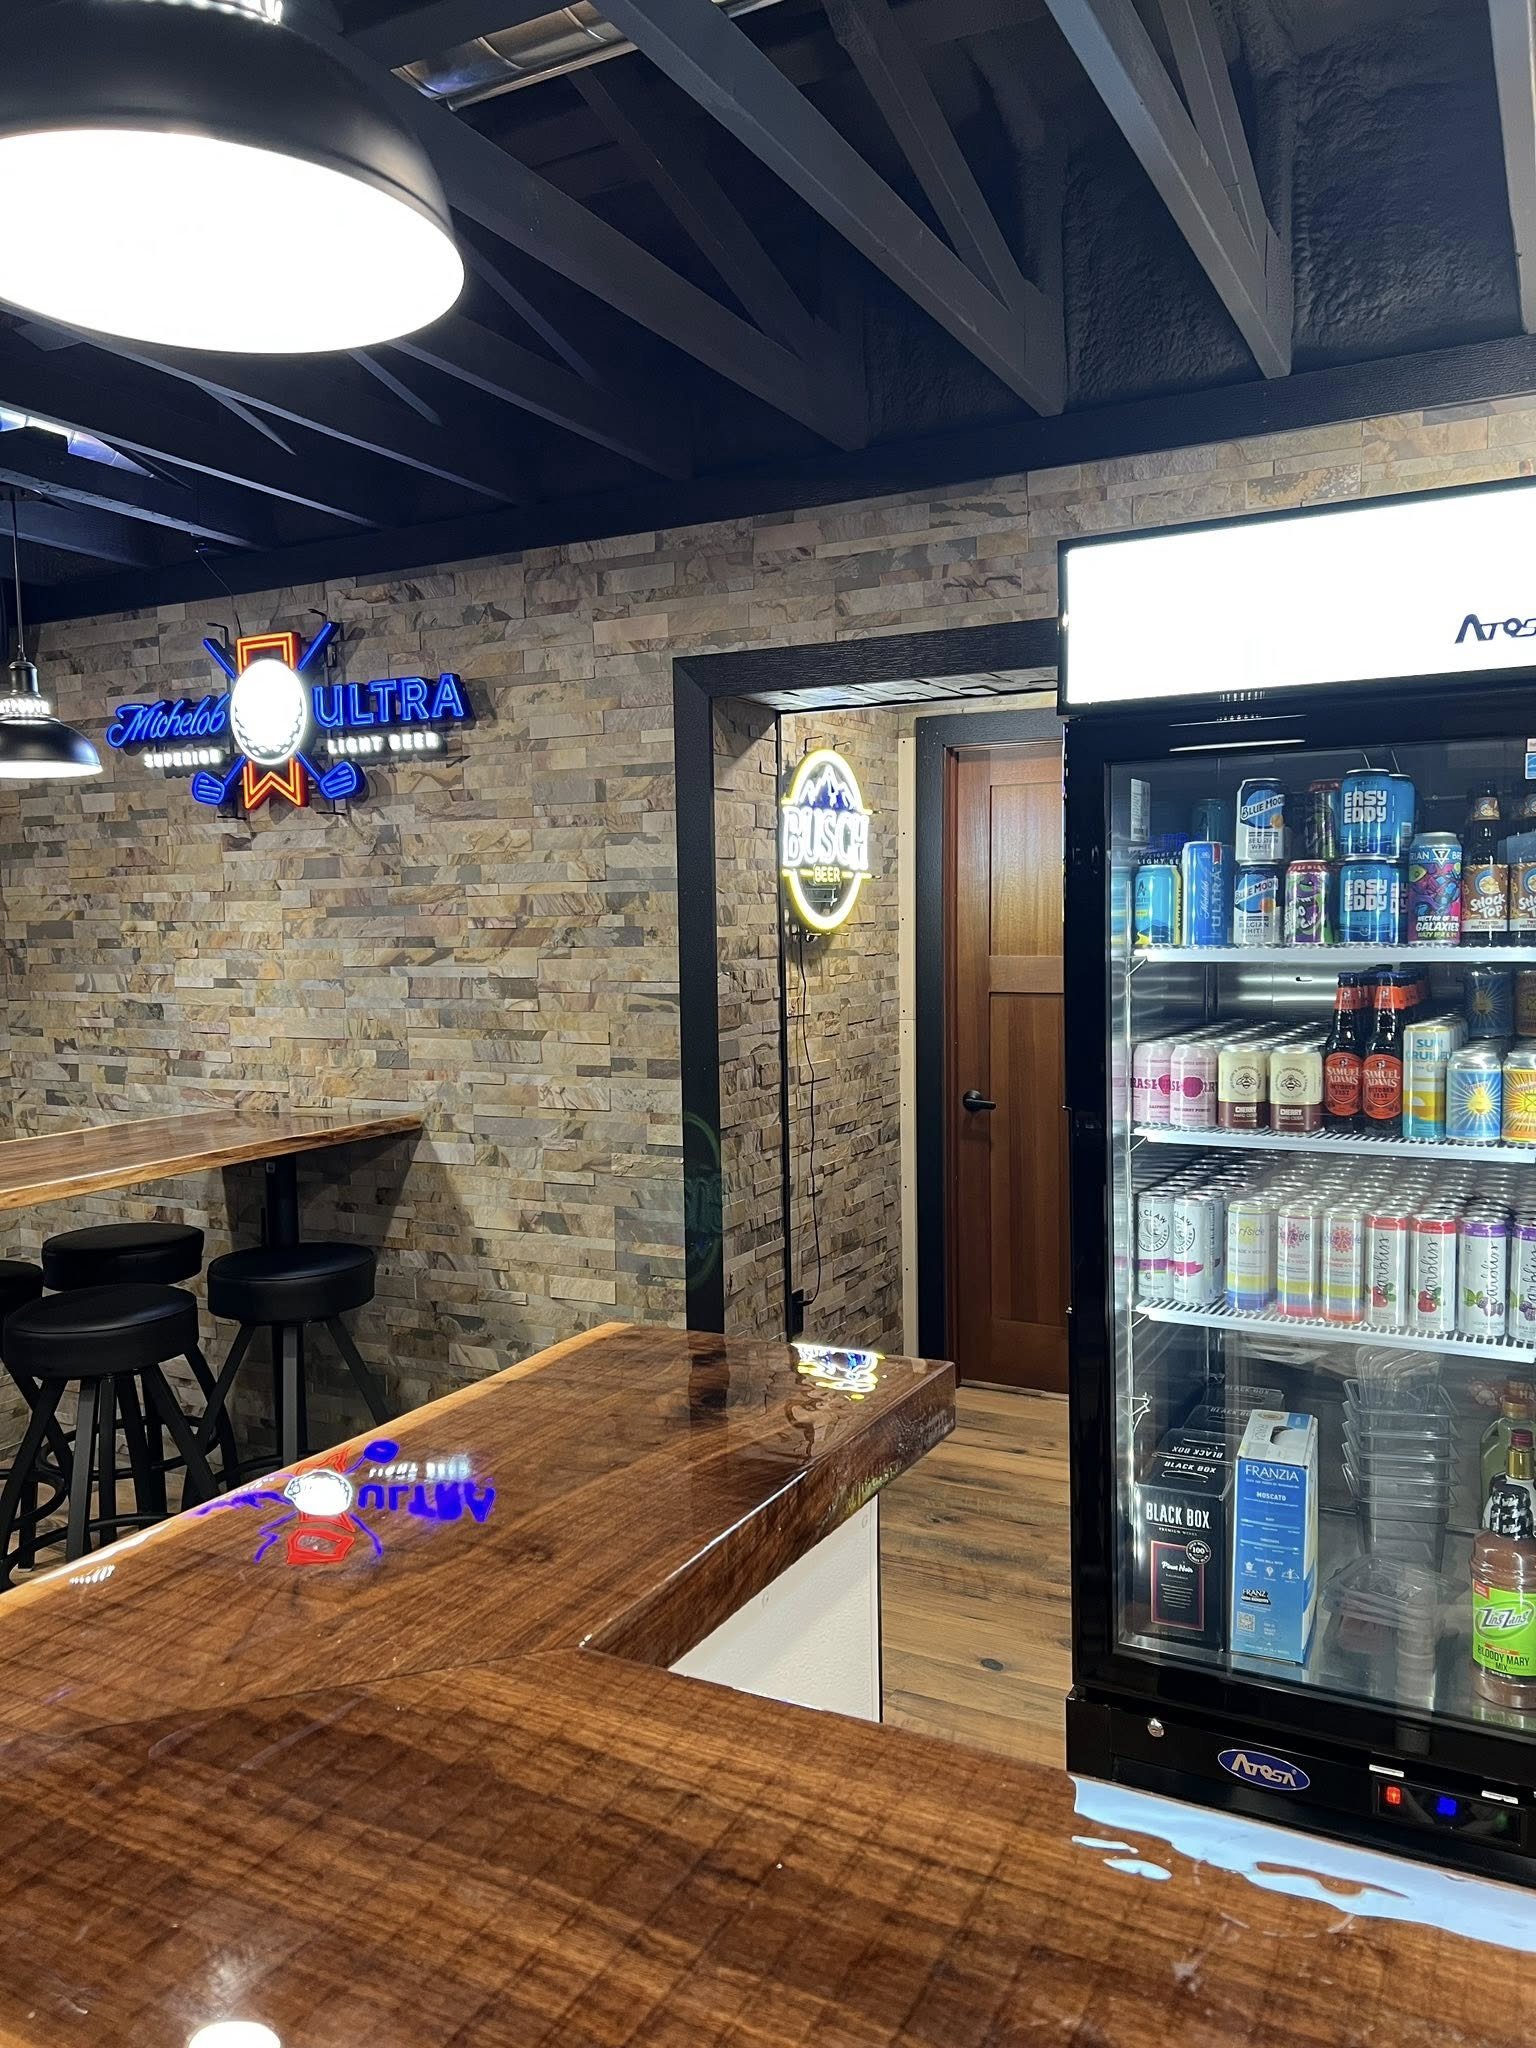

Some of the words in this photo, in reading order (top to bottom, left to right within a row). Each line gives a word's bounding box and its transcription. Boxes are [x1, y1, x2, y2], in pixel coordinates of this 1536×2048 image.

[106, 694, 229, 748] Michelob
[312, 673, 464, 729] ULTRA
[327, 737, 384, 755] LIGHT
[388, 731, 439, 751] BEER
[143, 748, 222, 769] SUPERIOR
[1344, 790, 1387, 807] EASY
[1241, 801, 1265, 819] BLUE
[1344, 806, 1387, 824] EDDY
[782, 806, 869, 870] BUSCH
[813, 865, 841, 883] BEER
[1235, 886, 1253, 904] BLUE
[1254, 878, 1279, 894] MOON
[1344, 879, 1388, 895] EASY
[1211, 868, 1222, 927] ULTRA
[1344, 894, 1387, 911] EDDY
[1470, 893, 1506, 911] SHOCK
[1479, 904, 1503, 918] TOP
[1415, 921, 1459, 932] GALAXIES
[1327, 1067, 1360, 1078] SAMUEL
[1328, 1075, 1359, 1085] ADAMS
[1364, 1069, 1401, 1080] SAMUEL
[1367, 1078, 1398, 1088] ADAMS
[1210, 1407, 1238, 1415] BLACK
[1172, 1446, 1191, 1454] BOX
[1193, 1449, 1223, 1459] BLACK
[1164, 1461, 1195, 1470] BLACK
[1197, 1465, 1217, 1473] BOX
[1245, 1464, 1299, 1482] FRANZIA
[1256, 1491, 1287, 1501] MOSCATO
[1145, 1502, 1182, 1525] BLACK
[1186, 1508, 1210, 1529] BOX
[1192, 1546, 1205, 1554] 100
[1478, 1645, 1506, 1663] BLOODY
[1506, 1655, 1530, 1666] MARY
[1495, 1662, 1508, 1672] MIX
